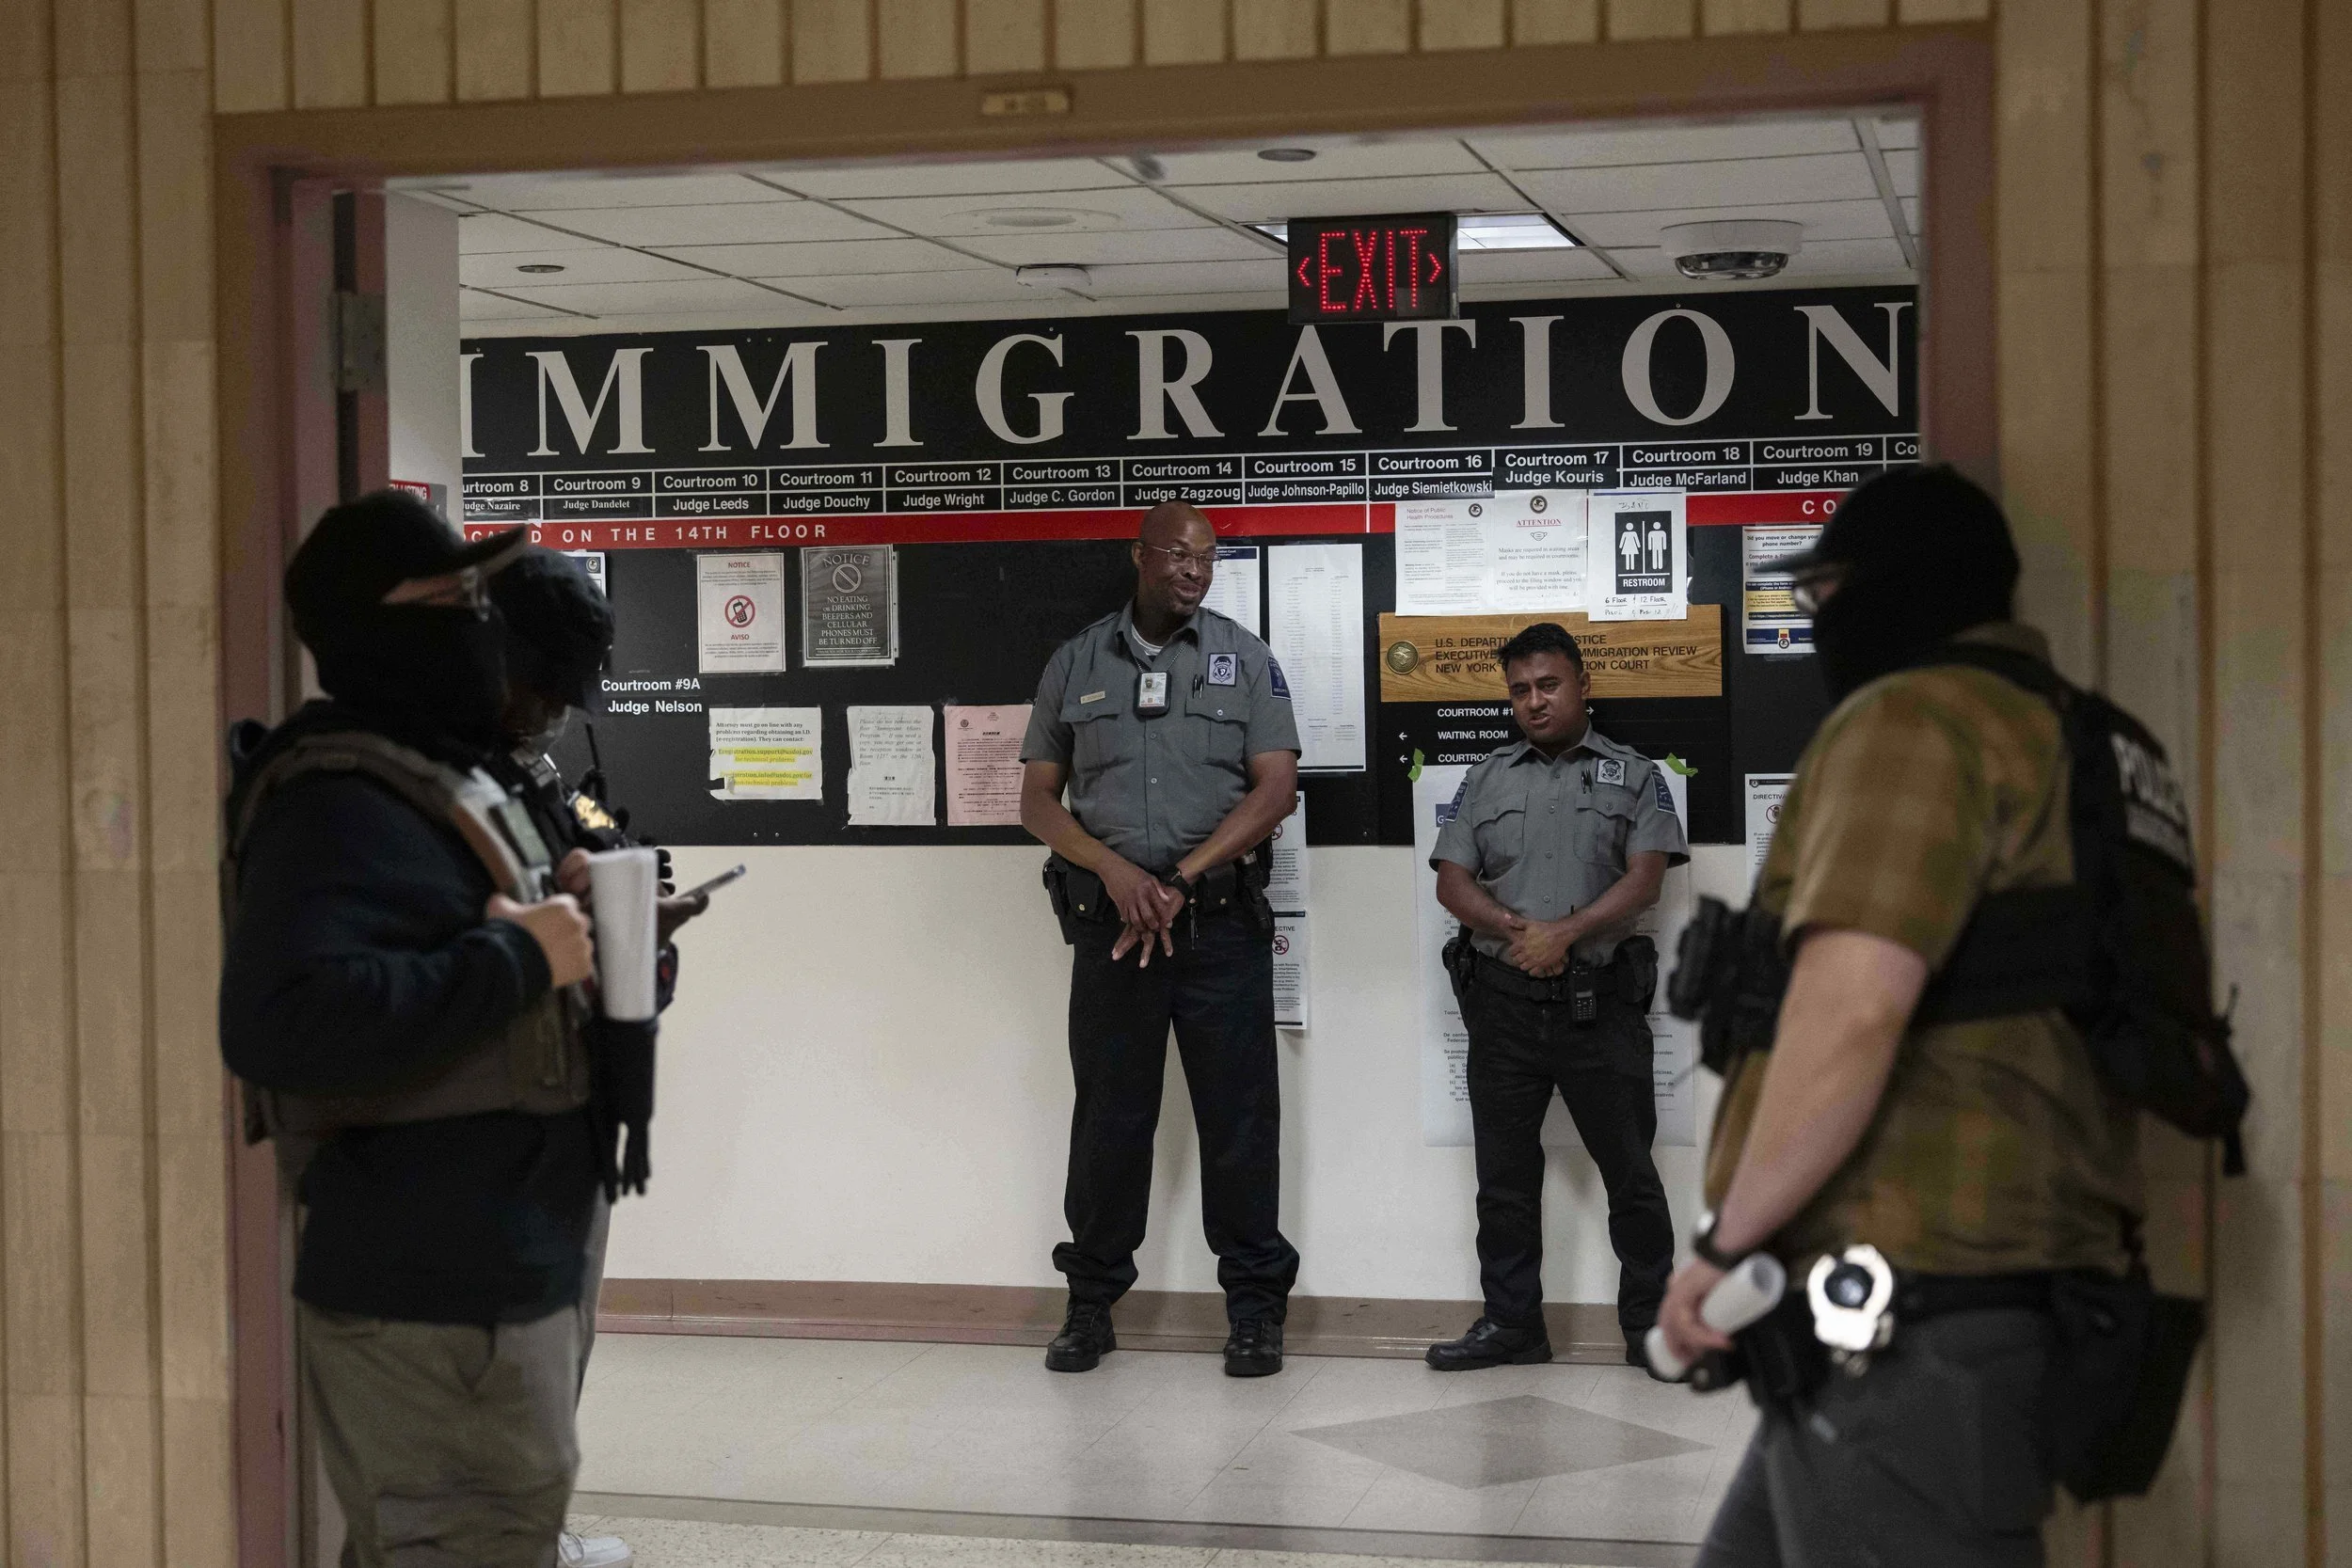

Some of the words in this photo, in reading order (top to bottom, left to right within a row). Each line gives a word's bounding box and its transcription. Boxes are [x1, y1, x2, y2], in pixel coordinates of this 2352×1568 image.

[1320, 230, 1429, 311] EXIT
[1632, 449, 1716, 464] Courtroom
[1722, 447, 1740, 460] 18
[1763, 445, 1849, 459] Courtroom
[1854, 443, 1873, 456] 19
[1254, 460, 1333, 474] Courtroom
[1339, 458, 1357, 471] 15
[1378, 456, 1458, 470] Courtroom
[1465, 454, 1483, 467] 16
[1505, 452, 1587, 467] Courtroom
[1593, 451, 1610, 464] 17
[895, 469, 970, 483] Courtroom
[976, 468, 992, 481] 12
[1012, 467, 1089, 481] Courtroom
[1095, 465, 1111, 478] 13
[1132, 464, 1211, 478] Courtroom
[1216, 462, 1232, 474] 14
[1505, 471, 1551, 486] Judge
[1556, 469, 1604, 483] Kouris
[1776, 471, 1820, 486] Judge
[1823, 469, 1859, 483] Khan
[554, 478, 626, 492] Courtroom
[631, 477, 642, 489] 9
[663, 475, 737, 489] Courtroom
[742, 474, 757, 486] 10
[780, 472, 854, 486] Courtroom
[860, 471, 873, 483] 11
[1629, 473, 1672, 488] Judge
[1676, 471, 1746, 485] McFarland
[463, 480, 514, 494] urtroom
[519, 480, 529, 492] 8
[1135, 487, 1176, 502] Judge
[1180, 486, 1241, 501] Zagzoug
[1248, 484, 1279, 499] Judge
[1281, 483, 1364, 499] Johnson-Papillo
[1375, 483, 1409, 498] Judge
[1412, 480, 1492, 495] Siemietkowski
[783, 497, 821, 511] Judge
[824, 496, 870, 510] Douchy
[903, 494, 941, 508] Judge
[944, 492, 985, 508] Wright
[1009, 491, 1048, 505] Judge
[1051, 490, 1064, 502] C.
[1068, 489, 1115, 501] Gordon
[463, 501, 485, 512] udge
[487, 501, 521, 511] Nazaire
[563, 500, 590, 511] Judge
[592, 499, 630, 509] Dandelet
[673, 499, 709, 513] Judge
[713, 497, 749, 511] Leeds
[1517, 518, 1562, 527] ATTENTION
[563, 529, 592, 543] ON
[612, 528, 656, 541] THE
[675, 526, 727, 540] 14TH
[751, 524, 826, 539] FLOOR
[822, 553, 870, 567] NOTICE
[1623, 578, 1666, 588] RESTROOM
[839, 594, 868, 603] EATING
[822, 612, 854, 621] BEEPERS
[855, 611, 873, 620] AND
[1435, 638, 1456, 648] U.S.
[1460, 637, 1512, 647] DEPARTM
[1574, 634, 1607, 644] STICE
[1436, 650, 1498, 660] EXECUTIVE
[1581, 646, 1648, 657] MMIGRATION
[1653, 645, 1698, 657] REVIEW
[1436, 663, 1462, 673] NEW
[1467, 662, 1498, 673] YORK
[1610, 659, 1650, 670] COURT
[601, 679, 672, 691] Courtroom
[675, 678, 701, 690] #9A
[608, 700, 649, 715] Judge
[655, 700, 703, 712] Nelson
[1437, 707, 1499, 718] COURTROOM
[1438, 730, 1476, 740] WAITING
[1479, 730, 1509, 739] ROOM
